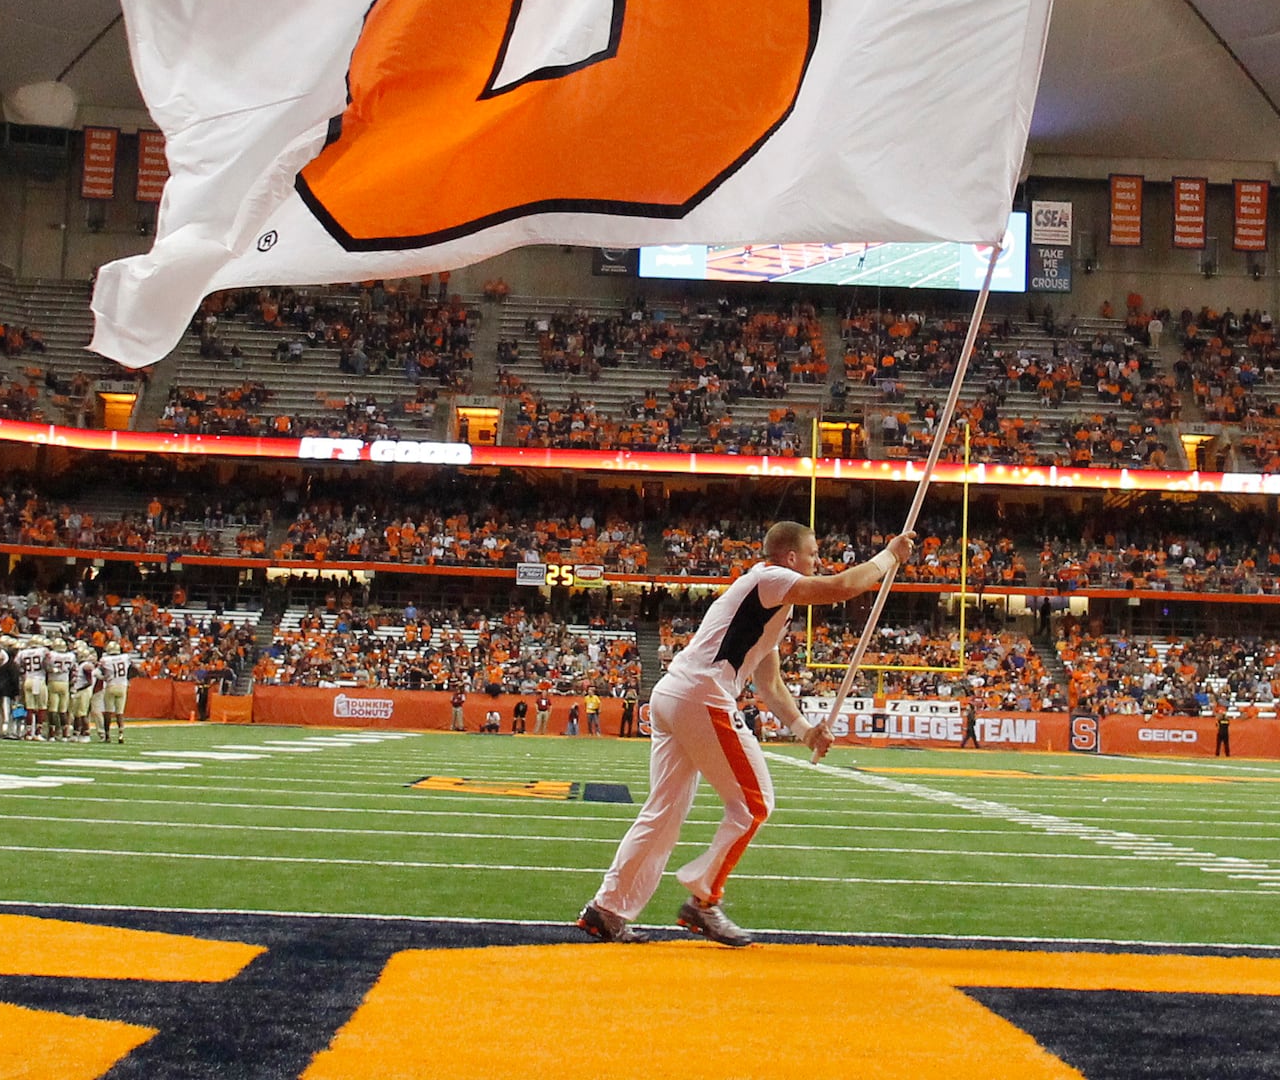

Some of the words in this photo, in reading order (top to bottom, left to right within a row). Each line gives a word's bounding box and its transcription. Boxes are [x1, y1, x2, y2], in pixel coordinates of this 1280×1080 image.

[1035, 208, 1068, 228] CSEA
[1039, 249, 1064, 259] TAKE
[1043, 260, 1058, 268] ME
[1044, 268, 1058, 277] TO
[1032, 278, 1070, 289] CROUSE
[546, 564, 573, 586] 25
[112, 662, 125, 678] 18
[351, 701, 393, 709] DUNKIN'
[891, 702, 959, 713] Zone
[351, 708, 389, 717] DONUTS
[855, 714, 963, 741] CLLEGE
[974, 718, 1037, 743] TEAM
[1071, 717, 1097, 751] S
[1138, 727, 1197, 743] GEICO
